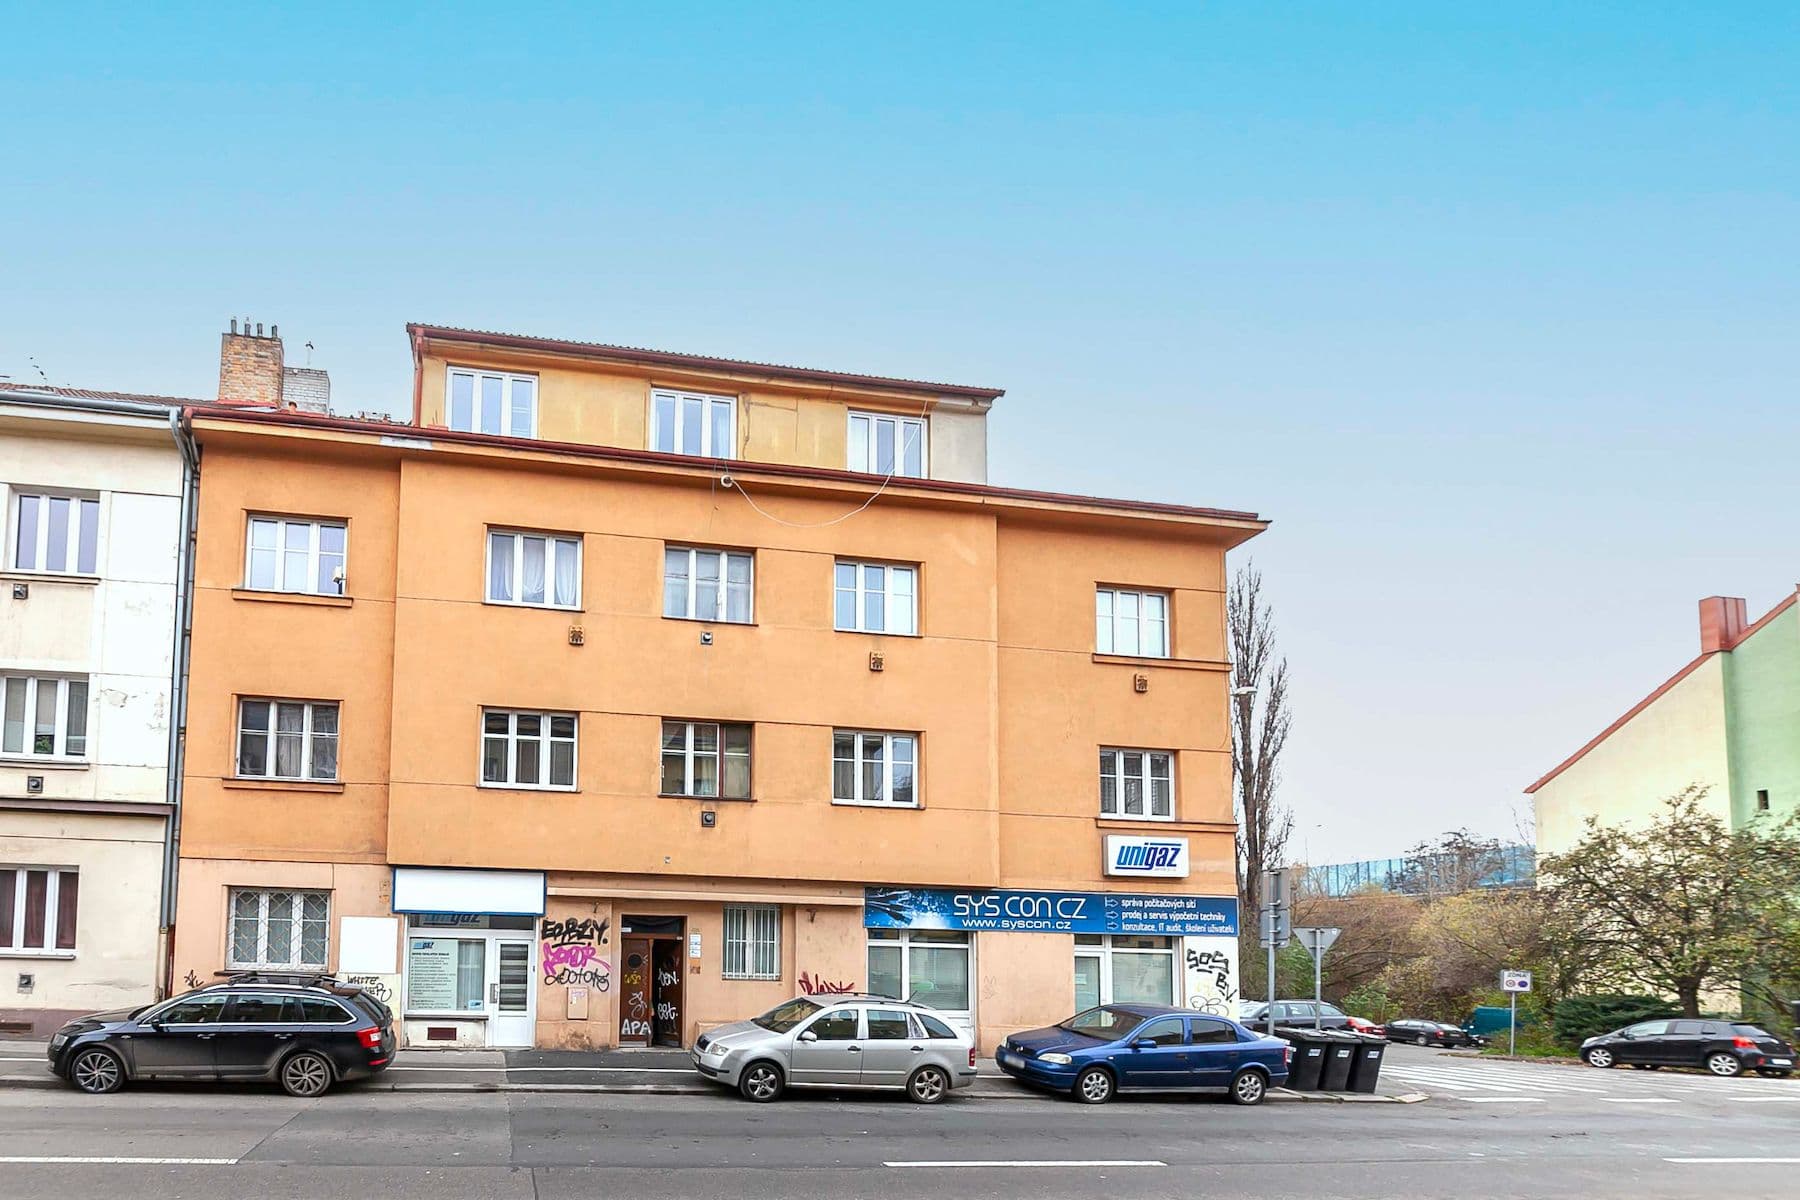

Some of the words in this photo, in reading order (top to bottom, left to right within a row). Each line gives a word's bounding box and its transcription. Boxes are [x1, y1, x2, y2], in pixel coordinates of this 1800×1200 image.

[1115, 842, 1182, 870] unigaz
[954, 895, 1000, 916] SYS
[1005, 896, 1052, 918] CON
[1056, 898, 1088, 919] CZ
[1121, 898, 1143, 908] správa
[1121, 910, 1142, 921] prodej
[1149, 911, 1168, 920] servis
[1200, 911, 1226, 923] techniky
[962, 919, 1071, 930] www.syscon.cz
